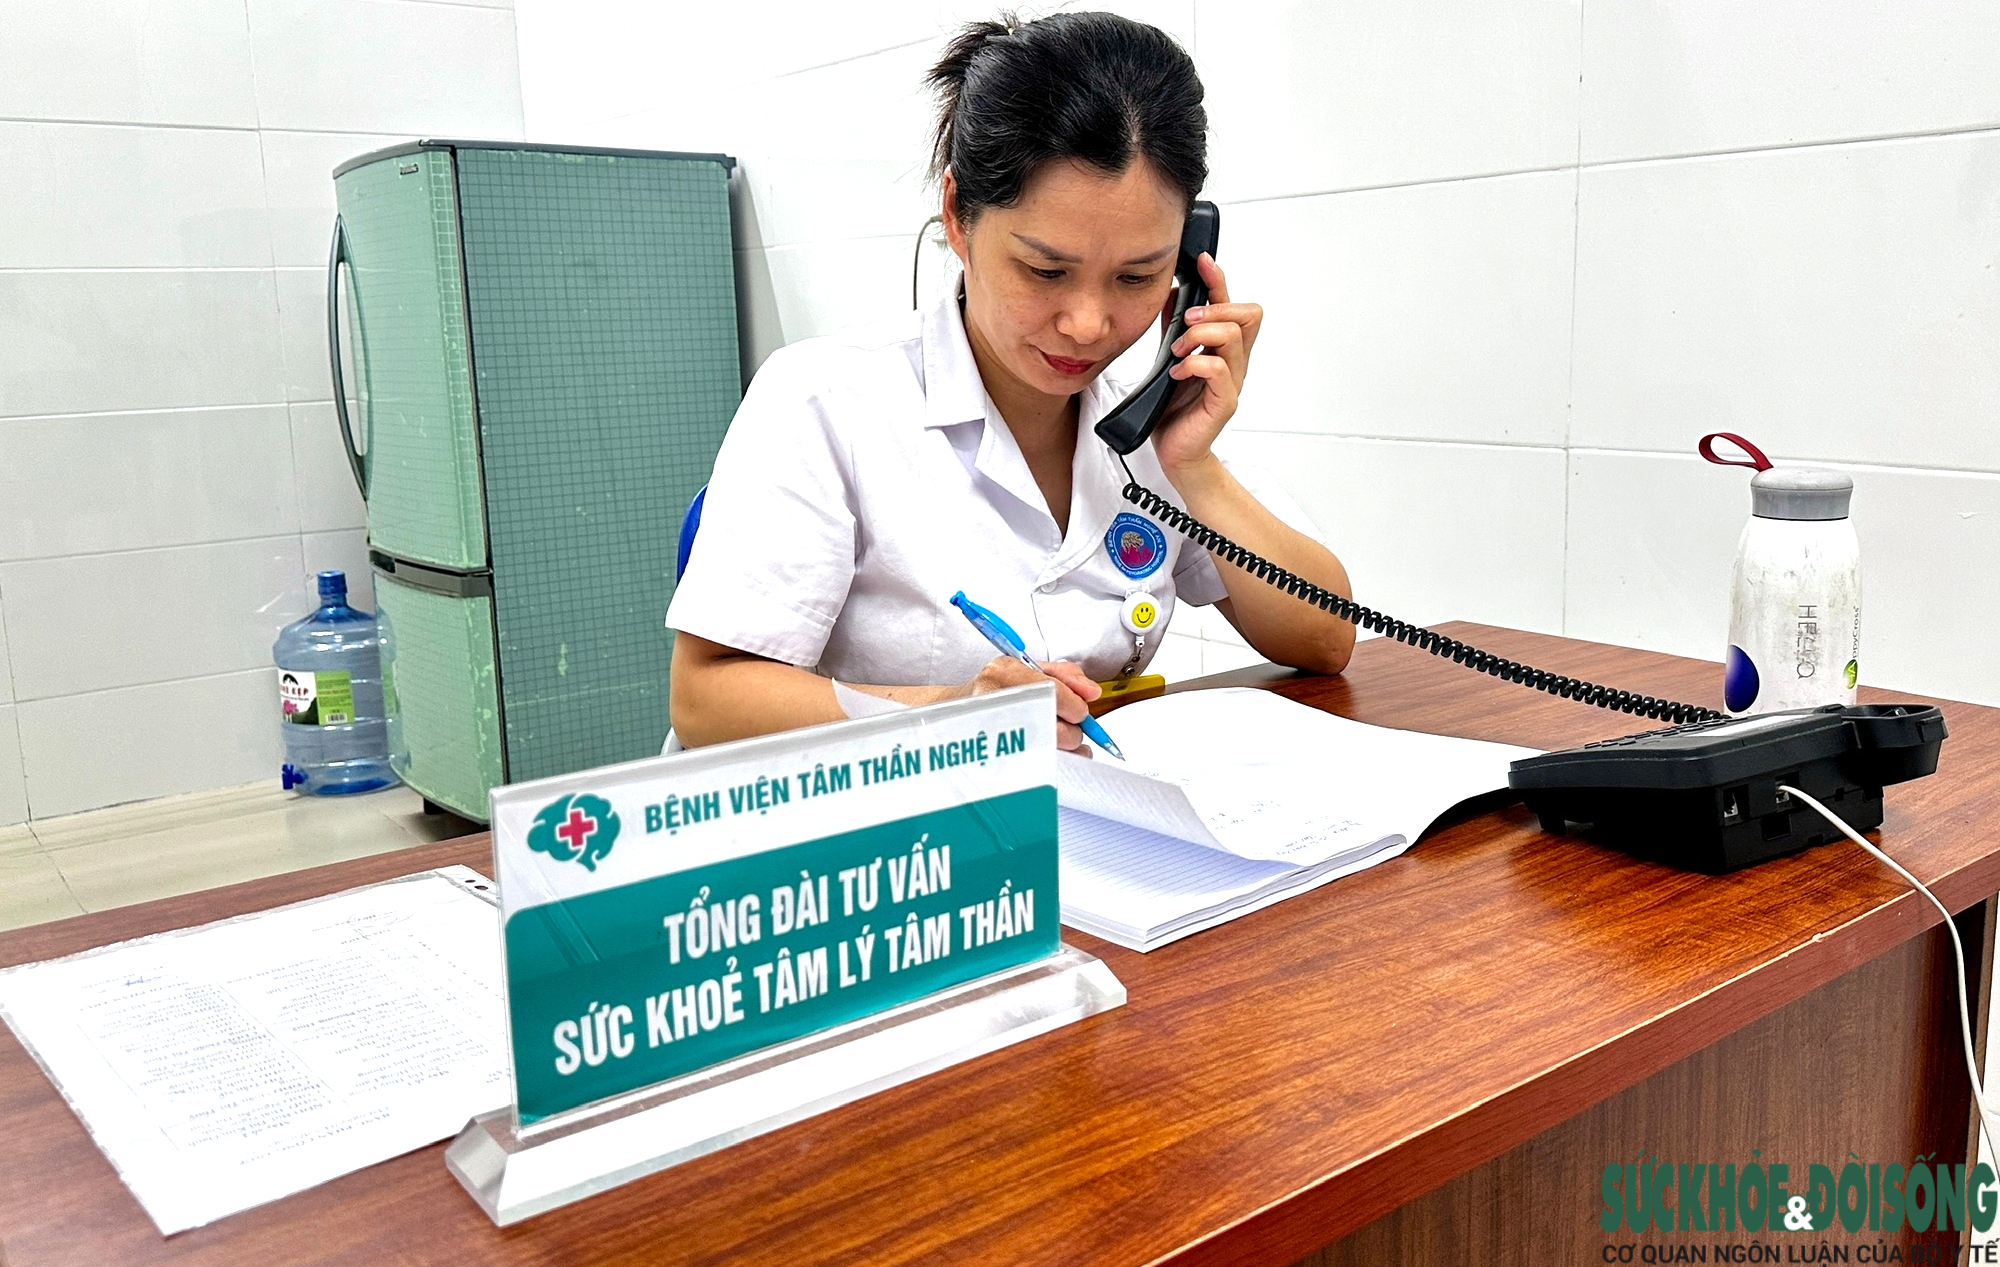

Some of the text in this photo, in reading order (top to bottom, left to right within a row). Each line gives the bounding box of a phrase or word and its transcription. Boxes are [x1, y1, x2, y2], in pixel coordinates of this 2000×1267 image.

[644, 727, 1026, 835] BỆNH VIỆN TÂM THẦN NGHỆ AN
[663, 832, 951, 965] TỔNG ĐÀI TƯ VẤN
[553, 878, 1034, 1076] SỨC KHOẺ TÂM LÝ TÂM THẦN
